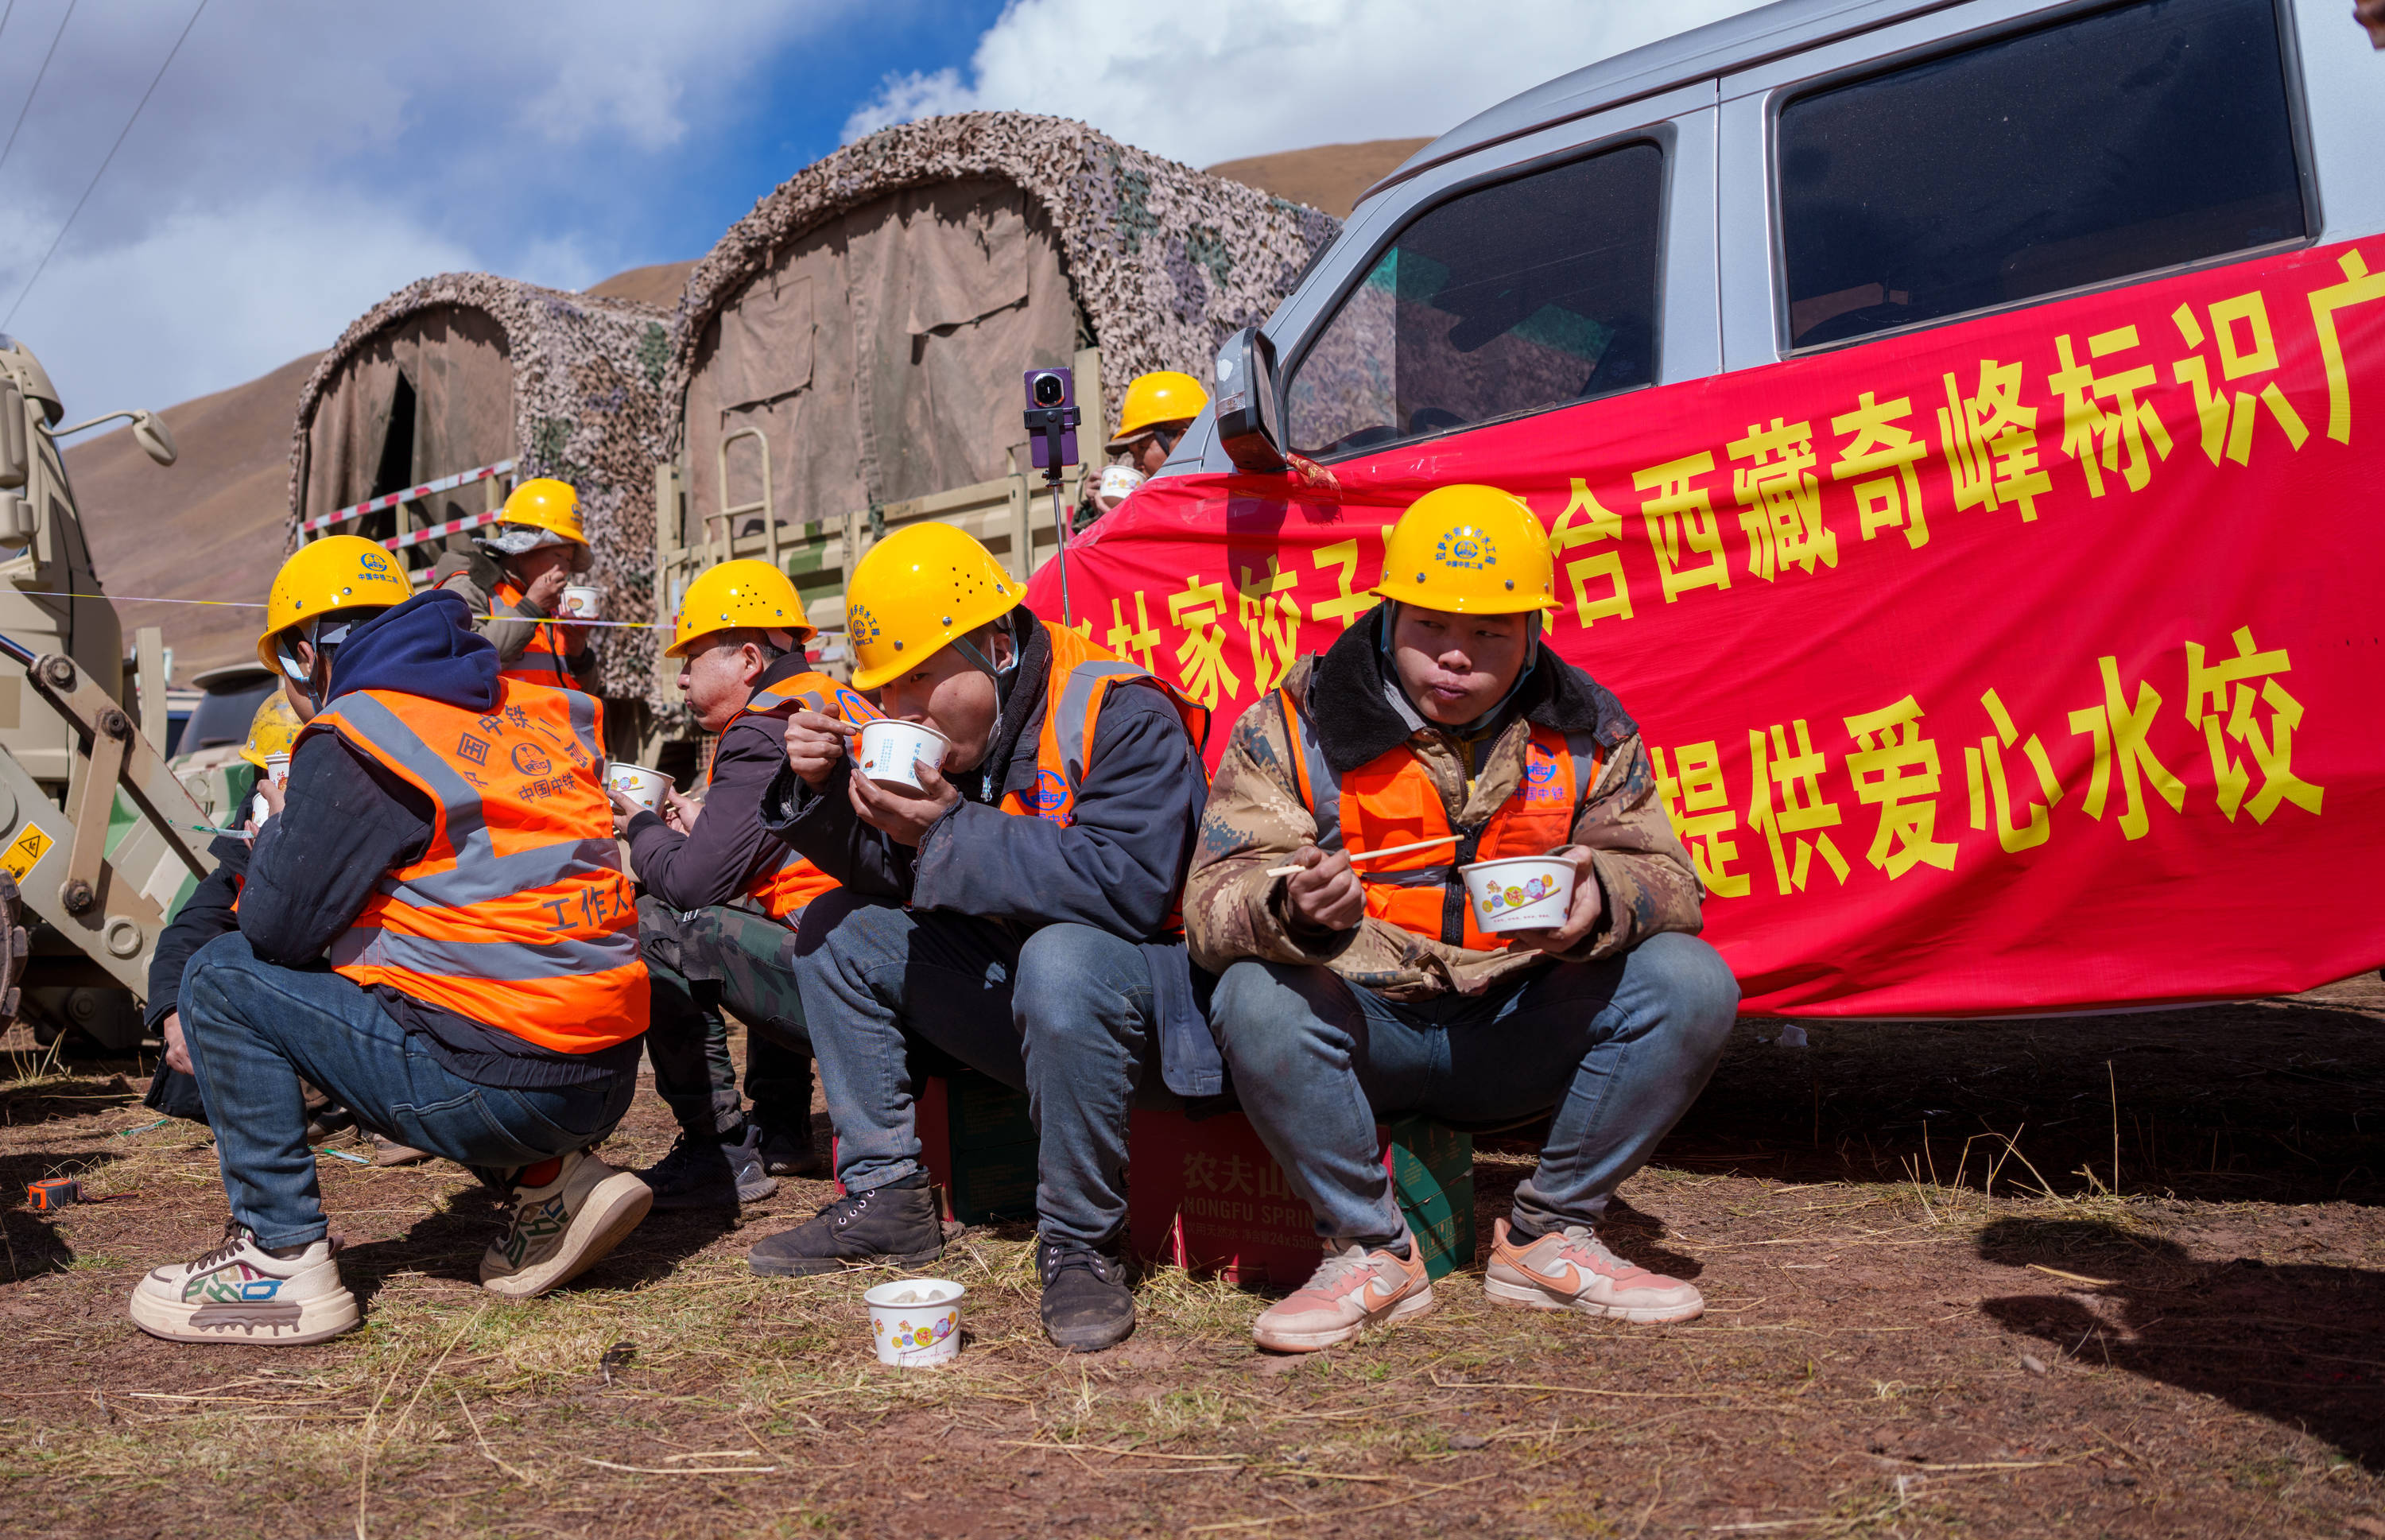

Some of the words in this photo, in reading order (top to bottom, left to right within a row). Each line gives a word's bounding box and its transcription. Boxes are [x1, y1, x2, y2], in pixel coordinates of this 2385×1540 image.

[1063, 248, 2385, 712] 杜家饺子合西藏奇峰标识广
[1650, 626, 2324, 898] 提供爱心水饺
[518, 772, 577, 803] 中国中铁
[1183, 1151, 1305, 1201] 农夫山
[1184, 1196, 1254, 1222] NONGFU
